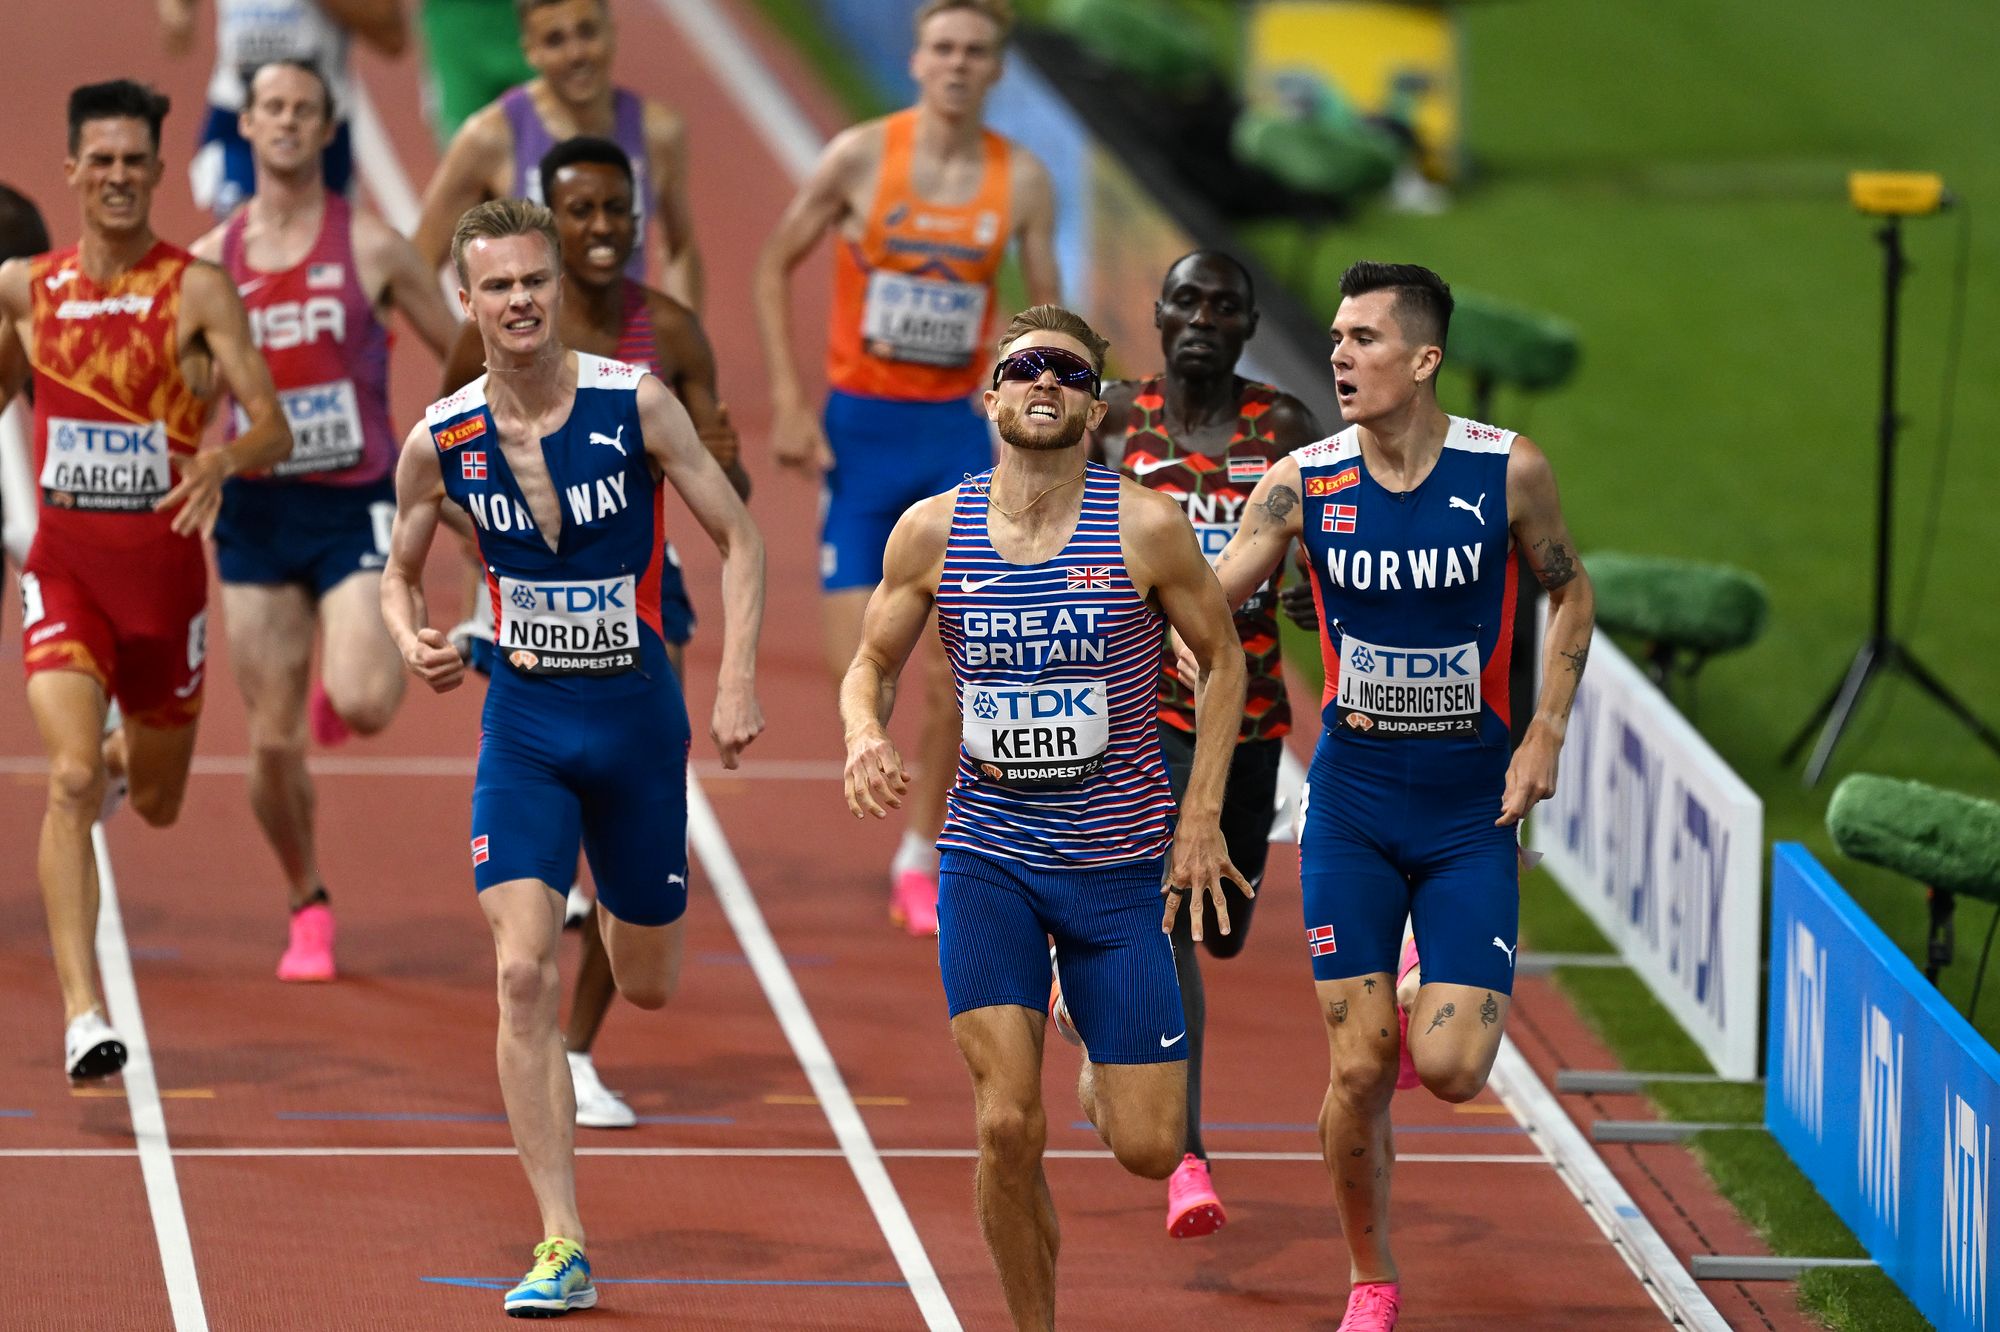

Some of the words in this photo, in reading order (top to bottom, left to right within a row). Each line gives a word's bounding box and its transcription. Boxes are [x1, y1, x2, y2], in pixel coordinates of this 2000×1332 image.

[77, 425, 158, 455] TDK
[454, 420, 483, 439] EXTRA
[55, 460, 158, 492] GARCÍA
[1326, 471, 1357, 492] EXTRA
[1327, 542, 1482, 592] NORWAY
[534, 581, 626, 614] TDK
[510, 617, 629, 651] NORDÅS
[963, 607, 1105, 638] GREAT
[542, 655, 614, 670] BUDAPEST
[616, 653, 633, 667] 23
[965, 638, 1105, 666] BRITAIN
[1374, 649, 1470, 679] TDK
[997, 687, 1098, 720] TDK
[1342, 676, 1354, 706] J.
[1359, 680, 1476, 714] INGEBRIGTSEN
[1378, 720, 1453, 732] BUDAPEST
[1455, 719, 1473, 730] 23
[991, 726, 1079, 759] KERR
[1007, 765, 1084, 780] BUDAPEST
[1783, 912, 1827, 1144] NTN
[1858, 994, 1903, 1240] NTN
[1942, 1081, 1990, 1332] NTN
